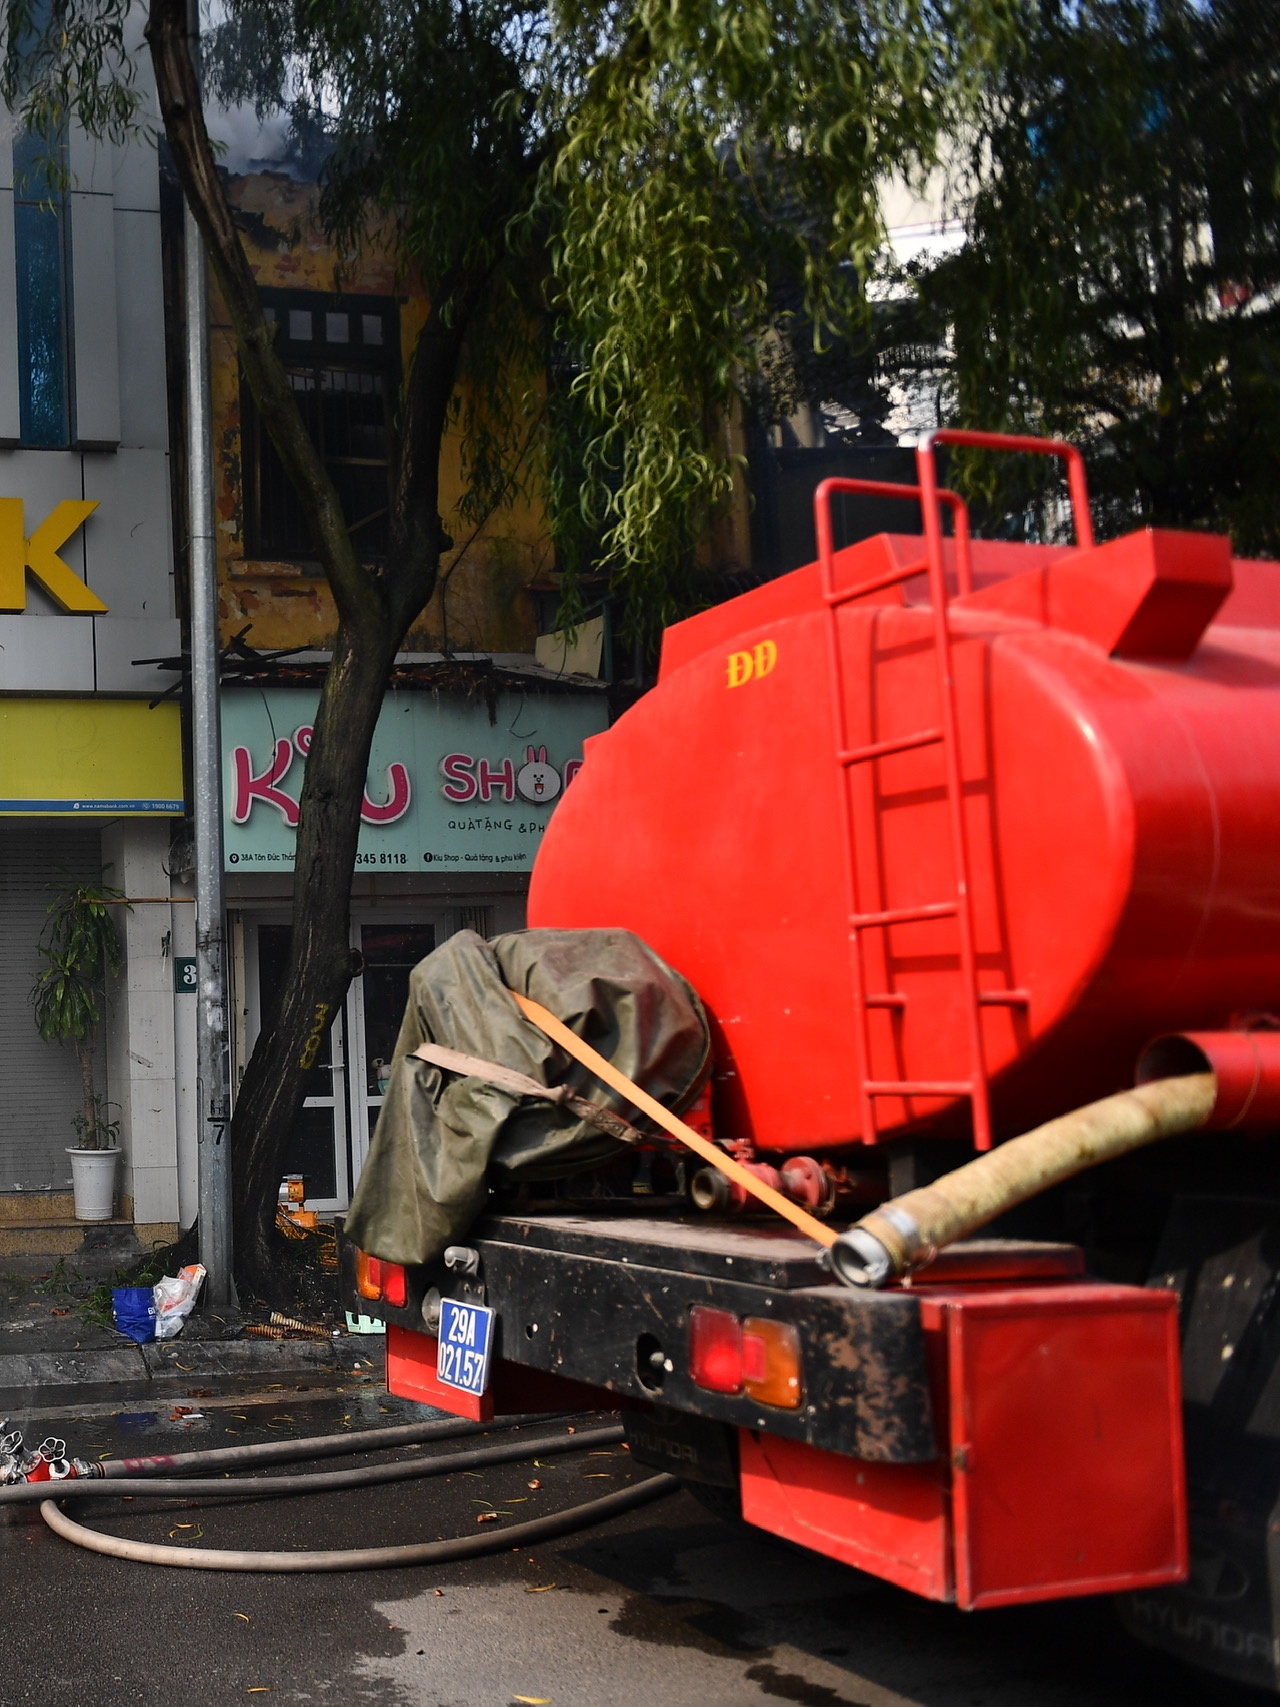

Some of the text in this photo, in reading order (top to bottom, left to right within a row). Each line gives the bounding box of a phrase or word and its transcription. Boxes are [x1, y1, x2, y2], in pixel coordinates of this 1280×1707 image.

[519, 822, 527, 834] &
[529, 823, 545, 833] PH
[241, 853, 253, 861] 38A
[255, 853, 266, 861] Tôn
[267, 853, 280, 861] Đức
[380, 853, 407, 864] 8118
[444, 854, 459, 862] Shop
[183, 964, 197, 985] 3
[213, 1125, 224, 1145] 7
[448, 1306, 477, 1347] 29A
[438, 1342, 484, 1390] 021.57
[1132, 1593, 1273, 1664] HYUNDA
